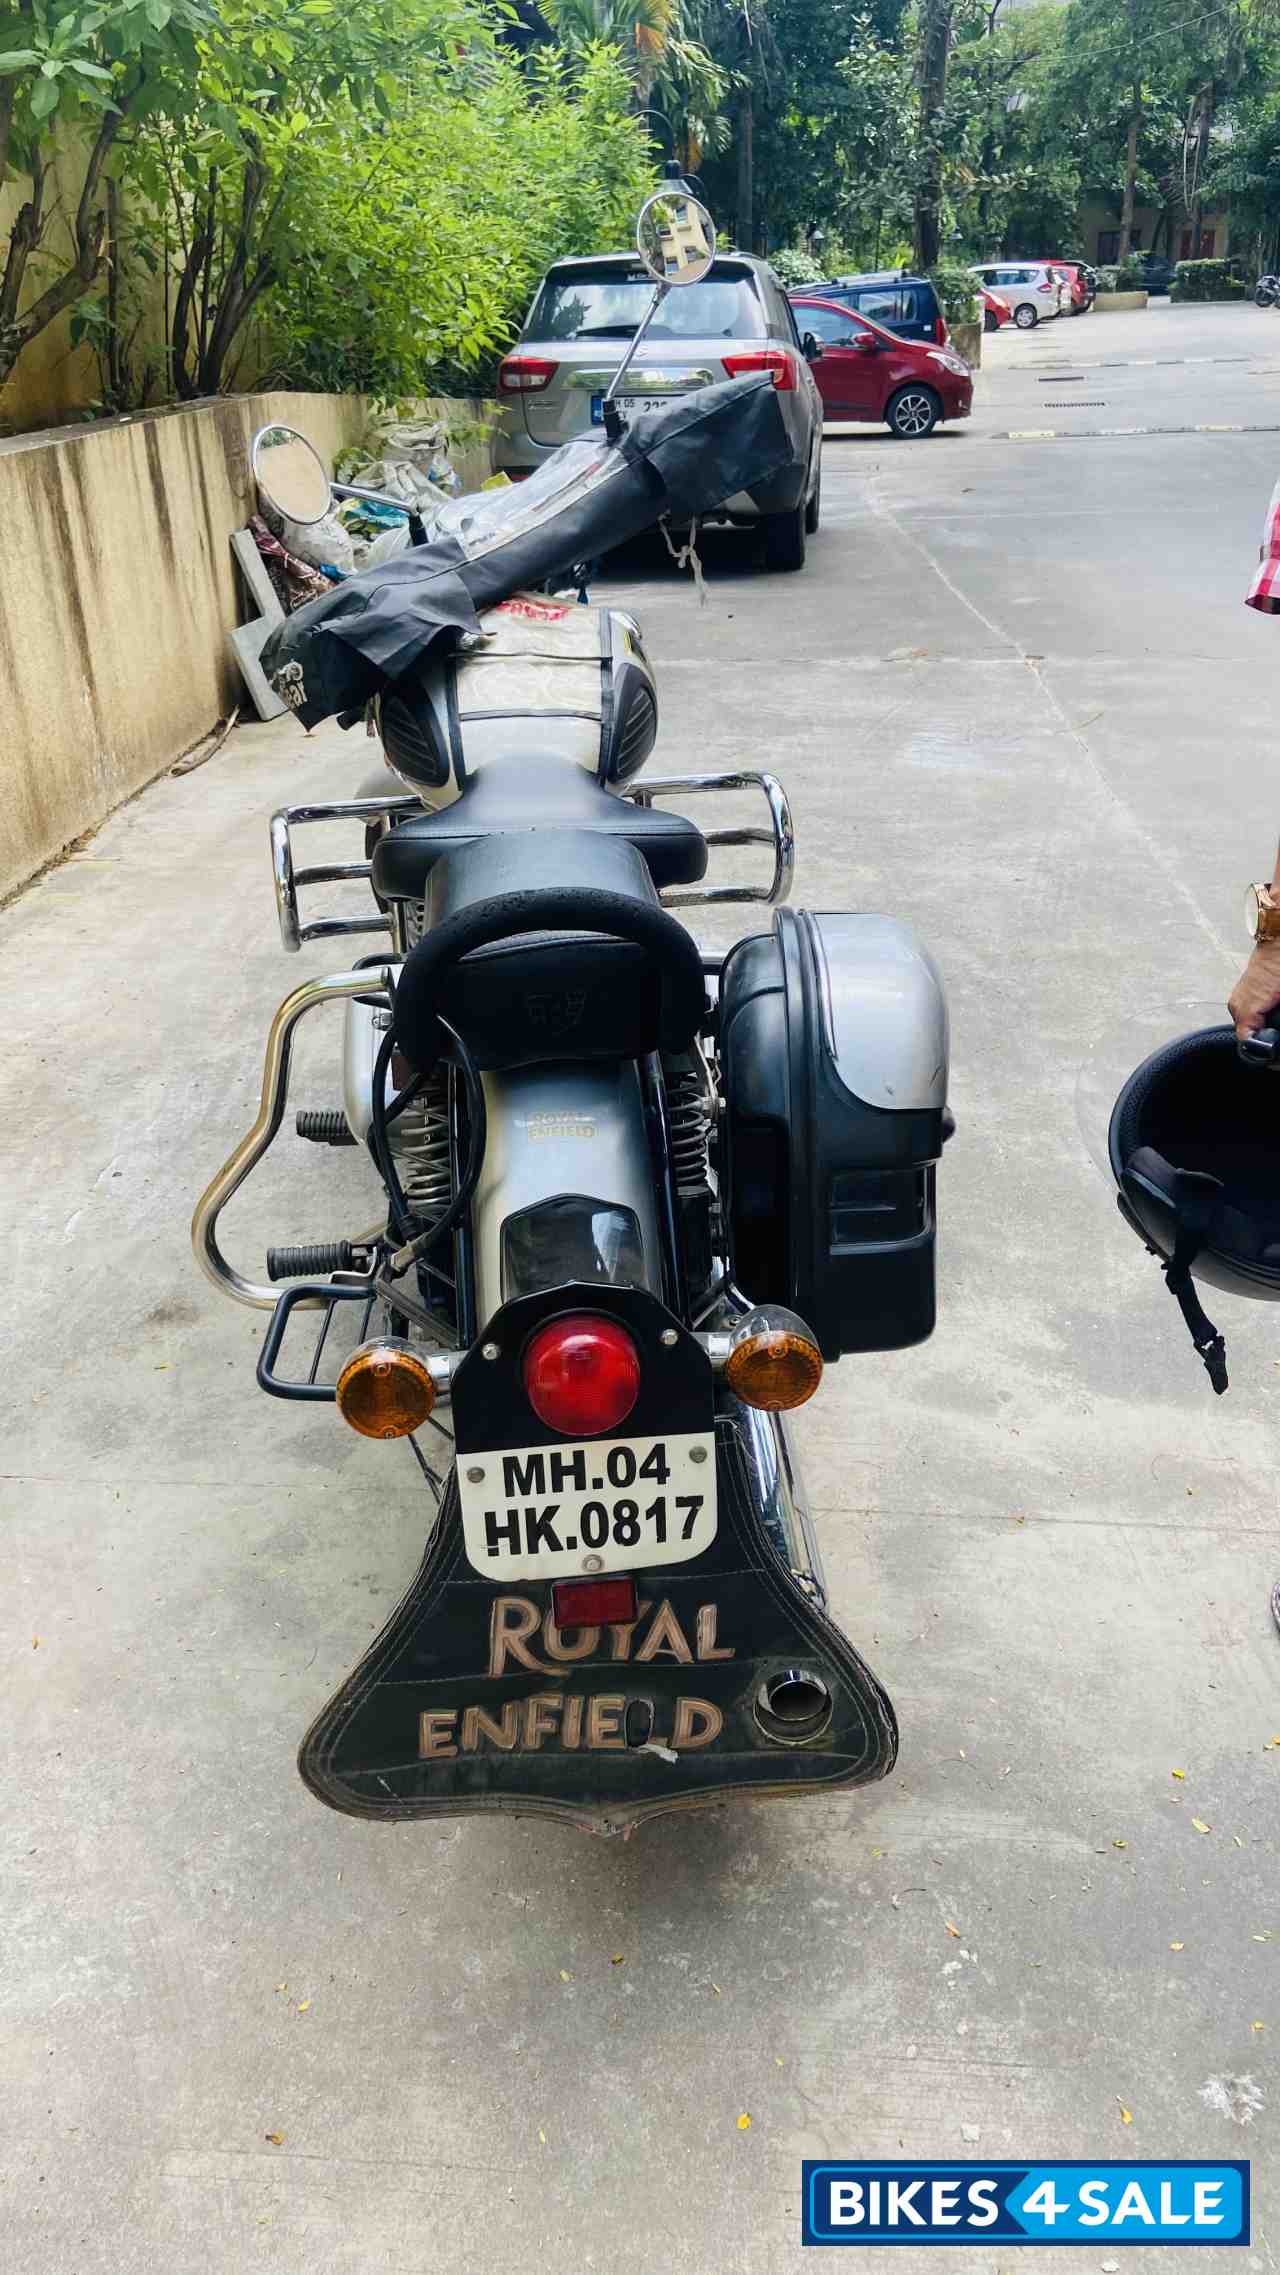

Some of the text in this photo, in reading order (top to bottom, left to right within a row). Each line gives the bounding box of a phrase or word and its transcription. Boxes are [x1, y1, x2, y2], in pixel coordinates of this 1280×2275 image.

[502, 1443, 671, 1497] MH.04
[484, 1495, 704, 1557] HK.0817
[418, 1693, 723, 1759] ENFIED
